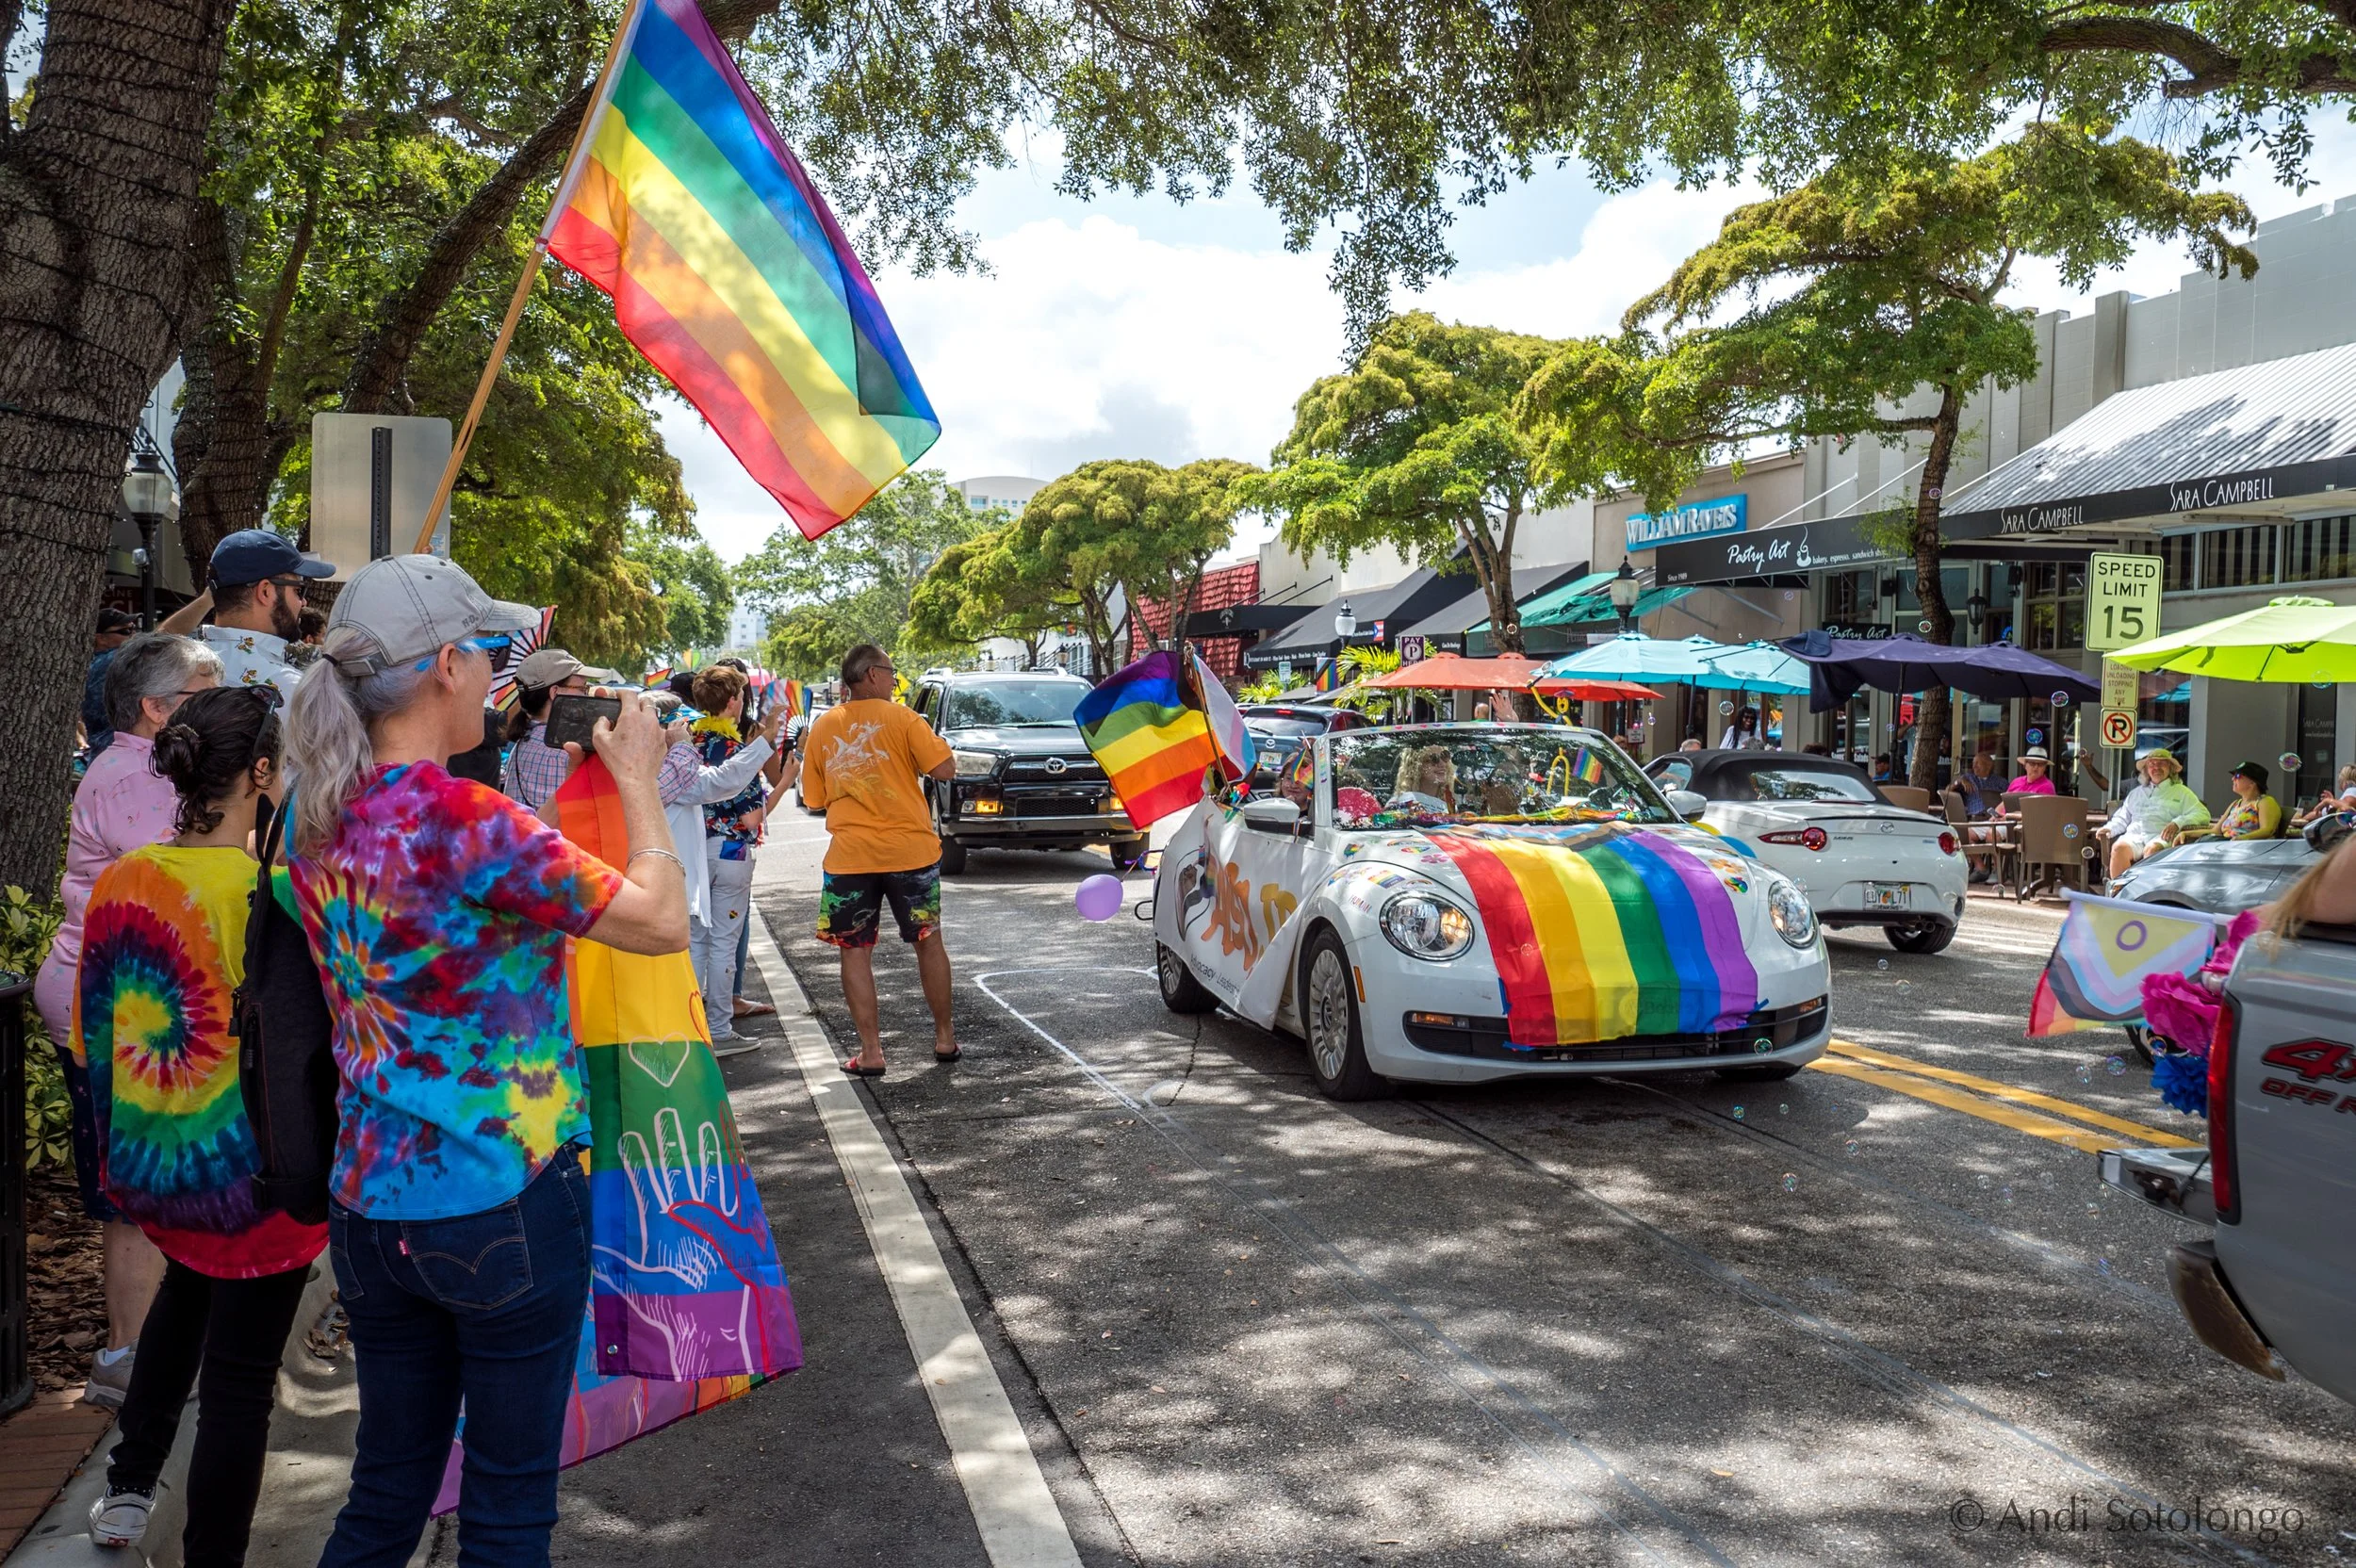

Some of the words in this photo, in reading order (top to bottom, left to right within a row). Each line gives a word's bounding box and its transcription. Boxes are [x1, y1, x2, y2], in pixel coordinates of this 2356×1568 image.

[2169, 482, 2200, 512] SARA
[2203, 477, 2273, 507] CAMPBELL
[1626, 513, 1687, 544] WILLIAM
[1686, 504, 1737, 535] RAVEIS
[2001, 509, 2025, 534] SARA
[2027, 505, 2084, 531] CAMPBELL
[1727, 544, 1765, 573] Pastry
[1768, 539, 1791, 561] Art
[1852, 548, 1874, 560] sandwich
[1667, 574, 1677, 582] Since
[2098, 562, 2155, 578] SPEED
[2103, 581, 2148, 597] LIMIT
[2103, 605, 2144, 640] 15
[1826, 625, 1862, 640] Pastry
[1866, 626, 1888, 639] Art
[1409, 646, 1417, 658] P
[2106, 671, 2135, 679] UNLOADING
[2261, 1076, 2338, 1105] OFF
